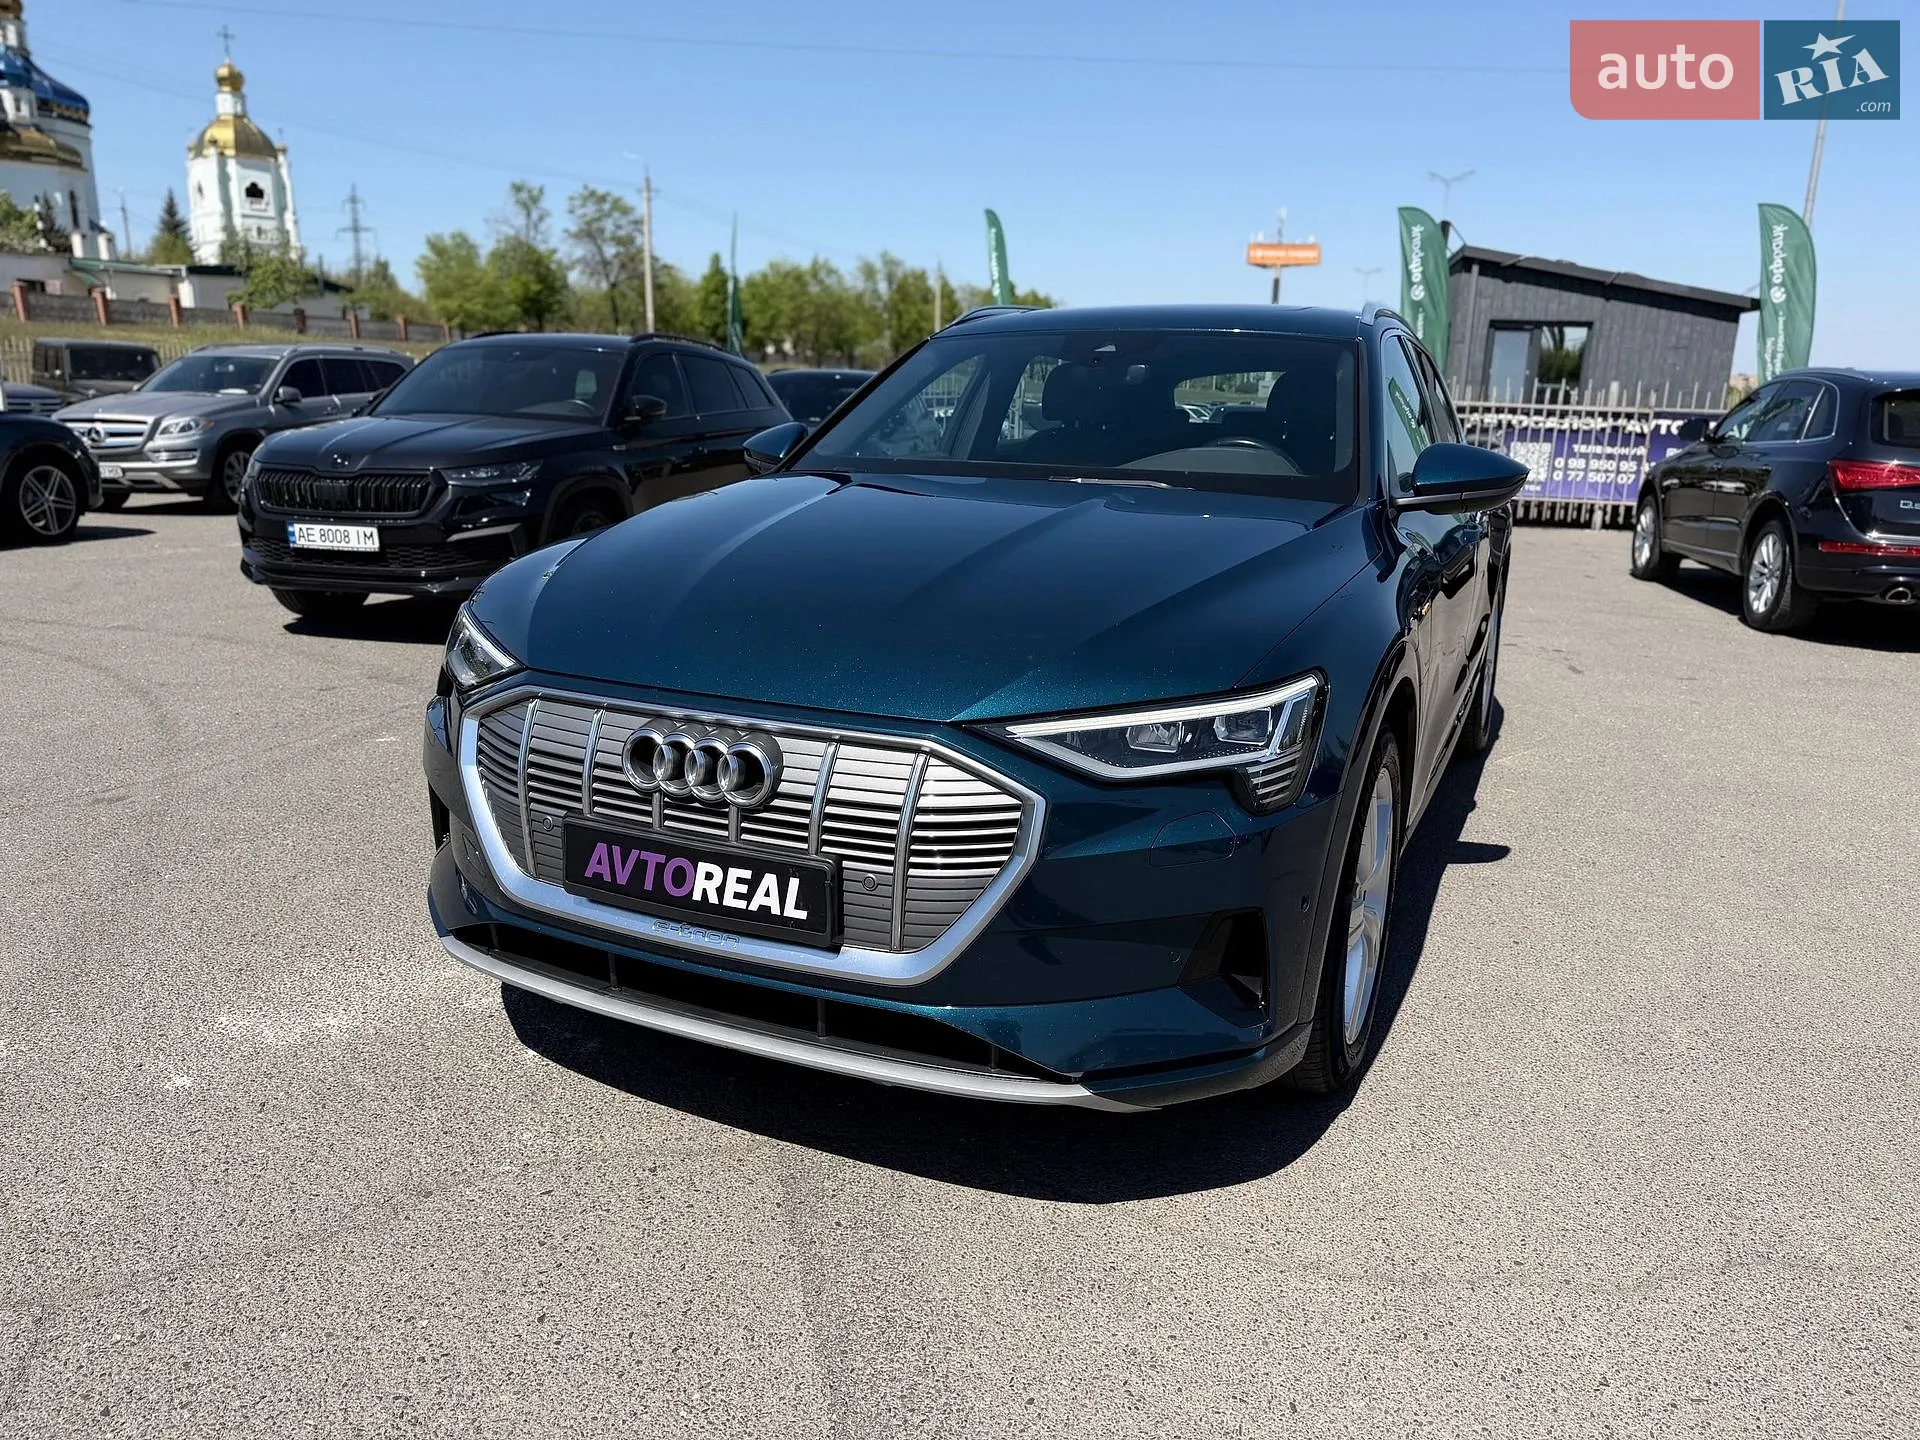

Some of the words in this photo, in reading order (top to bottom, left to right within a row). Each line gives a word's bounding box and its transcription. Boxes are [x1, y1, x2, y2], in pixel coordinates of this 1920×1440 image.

[298, 527, 317, 543] AE
[319, 527, 351, 544] 8008
[584, 842, 808, 920] AVTOREAL
[651, 919, 741, 949] e-tron
